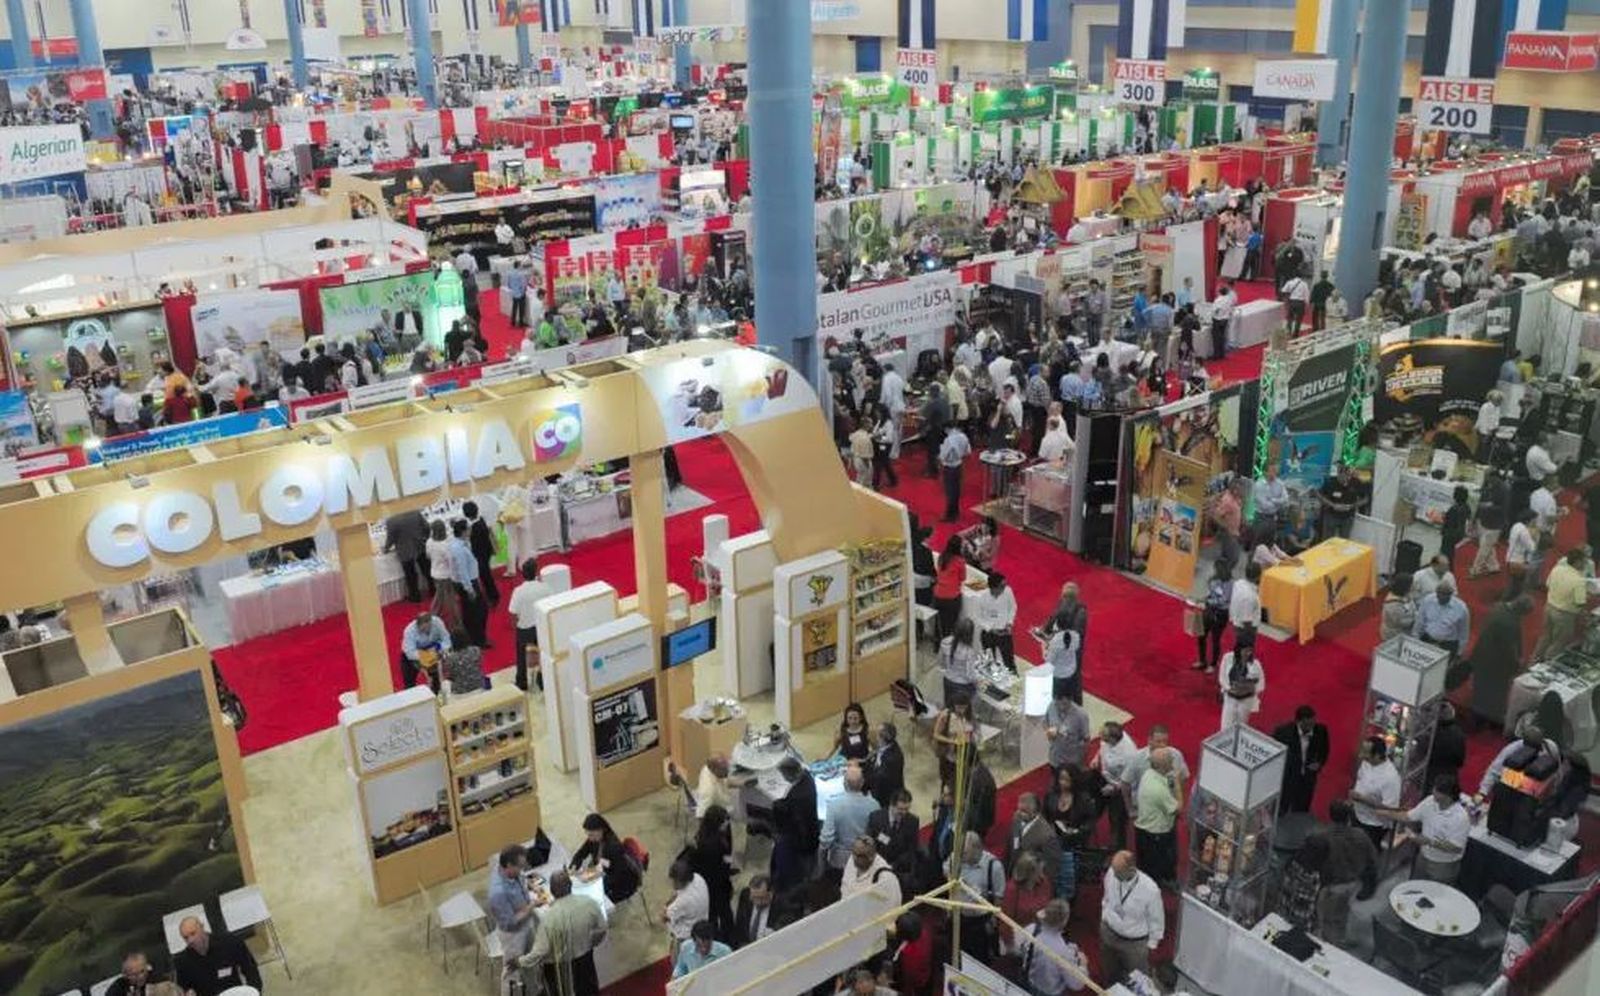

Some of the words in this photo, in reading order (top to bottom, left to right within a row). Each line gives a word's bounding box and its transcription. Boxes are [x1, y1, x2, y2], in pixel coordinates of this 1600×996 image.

[656, 29, 695, 44] uador
[899, 51, 936, 66] AISLE
[1508, 43, 1565, 60] PANAMA
[904, 69, 928, 84] 400
[1117, 62, 1165, 80] AISLE
[1123, 83, 1155, 101] 300
[1422, 81, 1492, 102] AISLE
[1430, 106, 1477, 128] 200
[10, 140, 77, 164] Algerian
[818, 288, 952, 329] talanGourmetUSA
[86, 420, 525, 567] COLOMBIA
